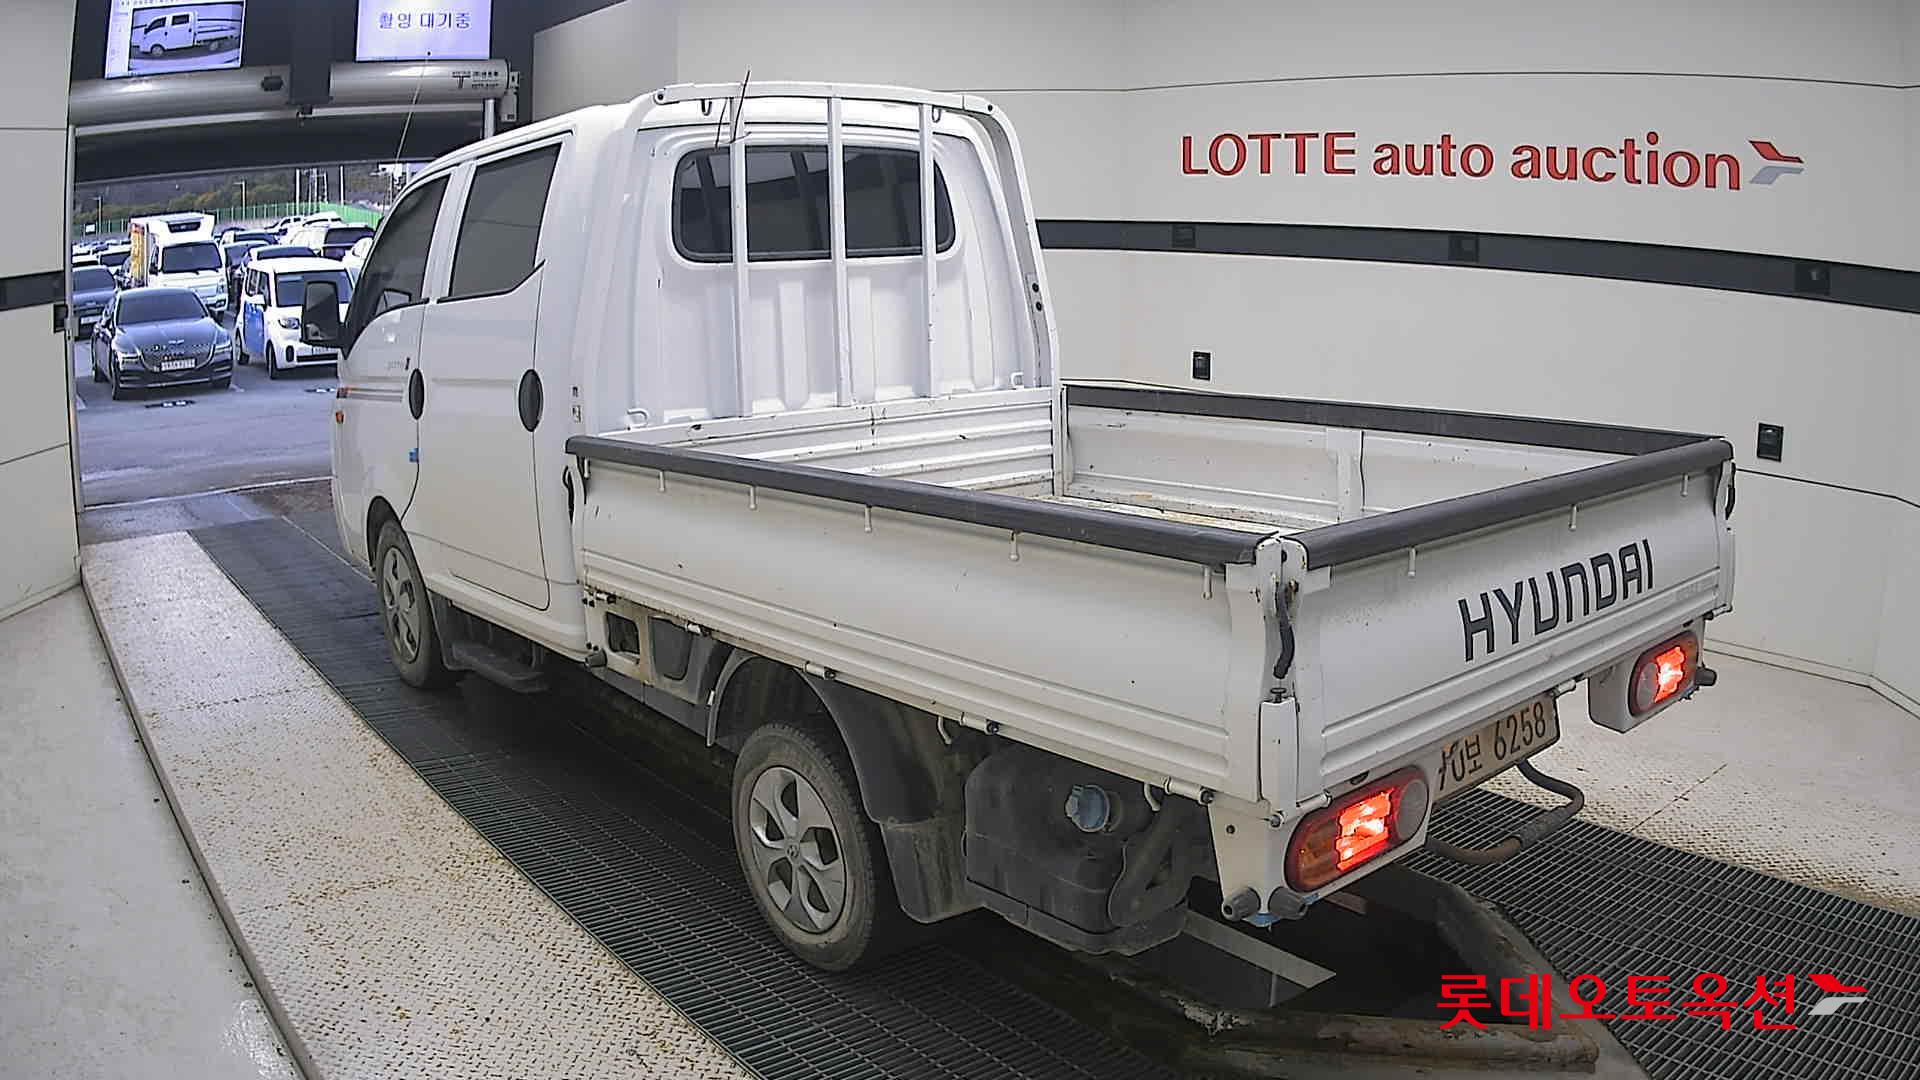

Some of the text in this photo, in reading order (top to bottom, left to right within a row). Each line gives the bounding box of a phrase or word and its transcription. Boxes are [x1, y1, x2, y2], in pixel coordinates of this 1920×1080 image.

[420, 11, 471, 30] 대기중
[1182, 131, 1741, 191] LOTTE auto auction
[1457, 539, 1654, 663] HYUNDAI
[1494, 701, 1546, 761] 6258
